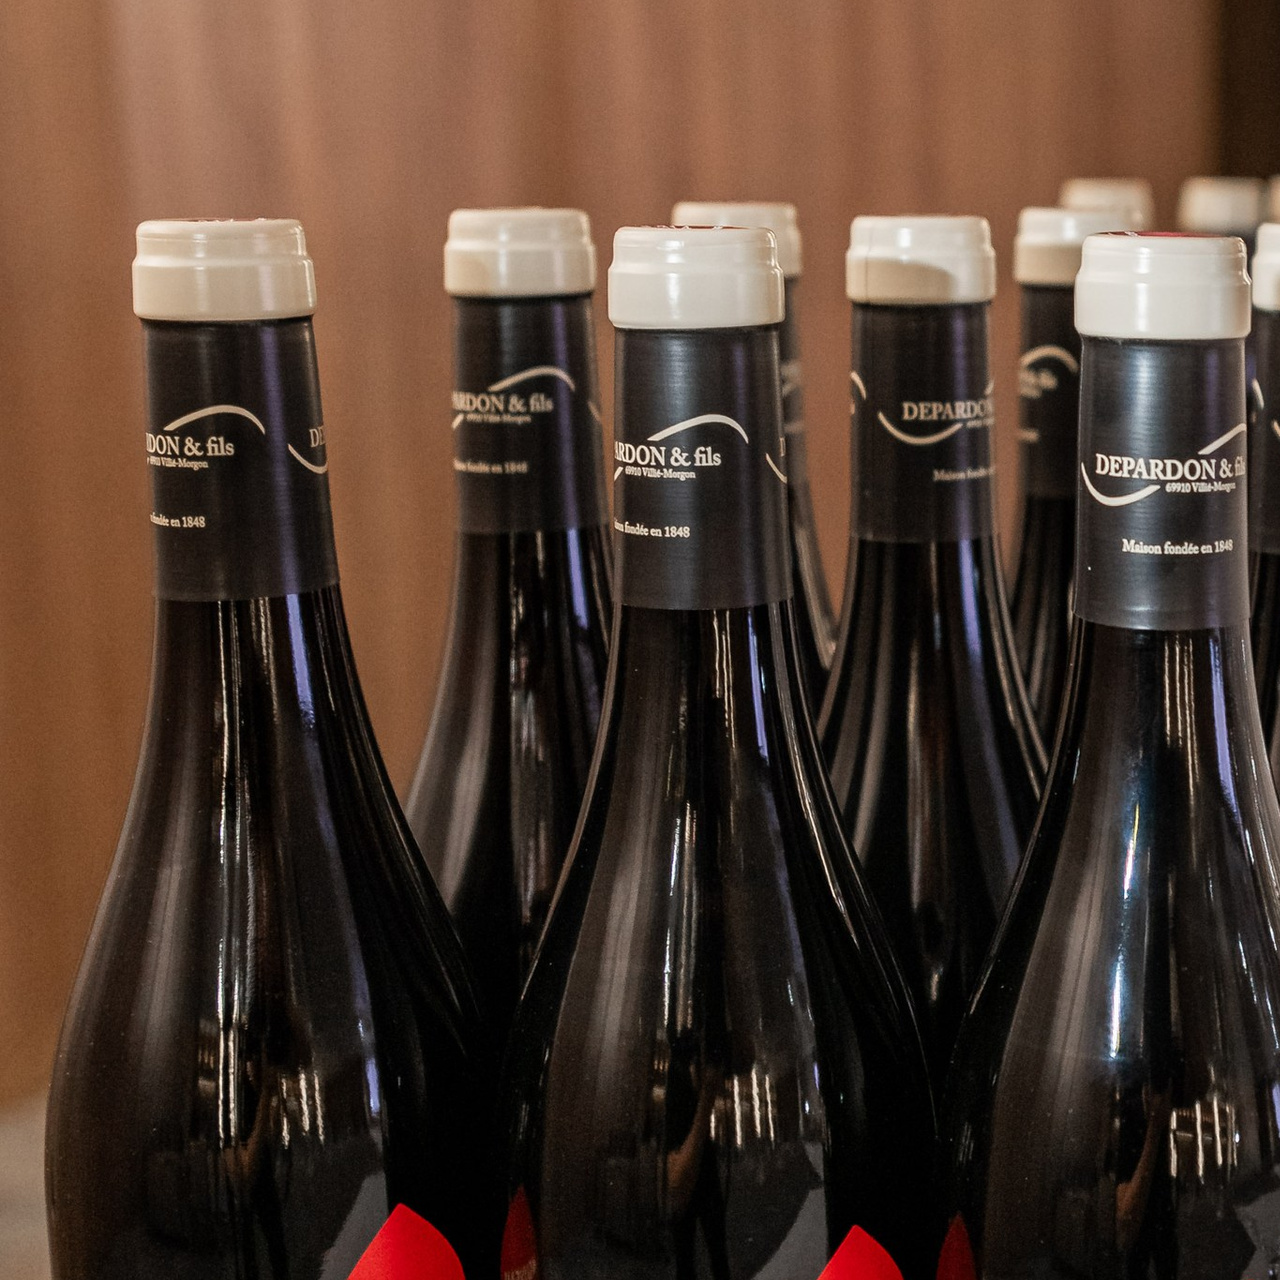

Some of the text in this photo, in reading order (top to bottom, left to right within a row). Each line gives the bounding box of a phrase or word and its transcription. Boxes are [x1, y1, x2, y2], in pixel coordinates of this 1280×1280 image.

[184, 436, 204, 456] &
[206, 436, 235, 457] fils
[670, 446, 691, 467] &
[694, 446, 722, 466] fils
[1095, 453, 1217, 480] DEPARDON
[1219, 458, 1233, 478] &
[1165, 482, 1191, 493] 69910
[182, 516, 206, 528] 1848
[650, 528, 662, 537] en
[664, 526, 690, 538] 1848
[1122, 538, 1162, 555] Maison
[1201, 545, 1213, 554] en
